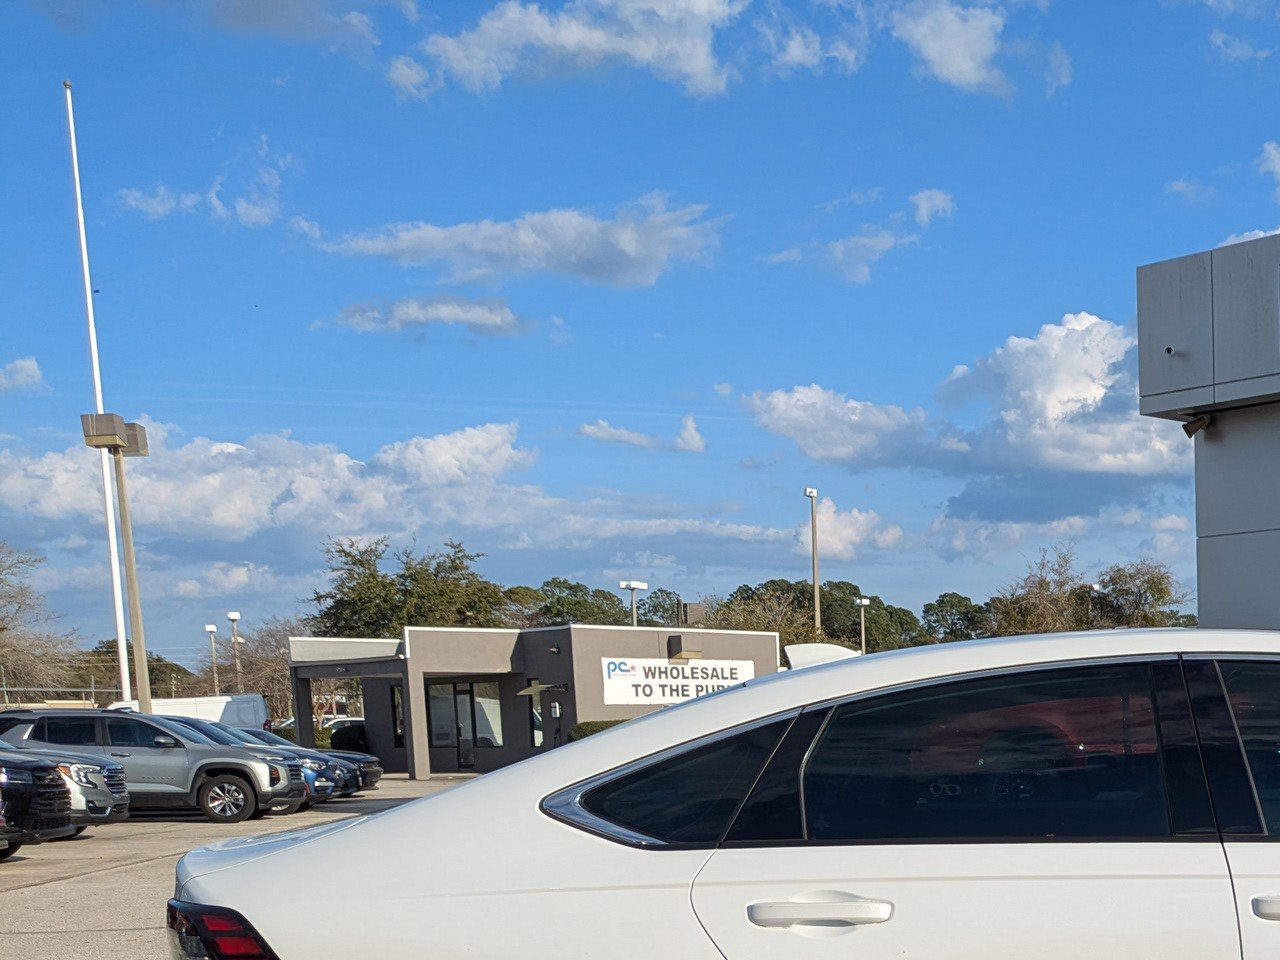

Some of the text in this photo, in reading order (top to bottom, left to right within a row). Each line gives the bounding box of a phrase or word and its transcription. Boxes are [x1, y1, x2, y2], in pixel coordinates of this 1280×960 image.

[642, 666, 738, 680] WHOLESALE
[632, 684, 653, 697] TO
[659, 684, 690, 697] THE
